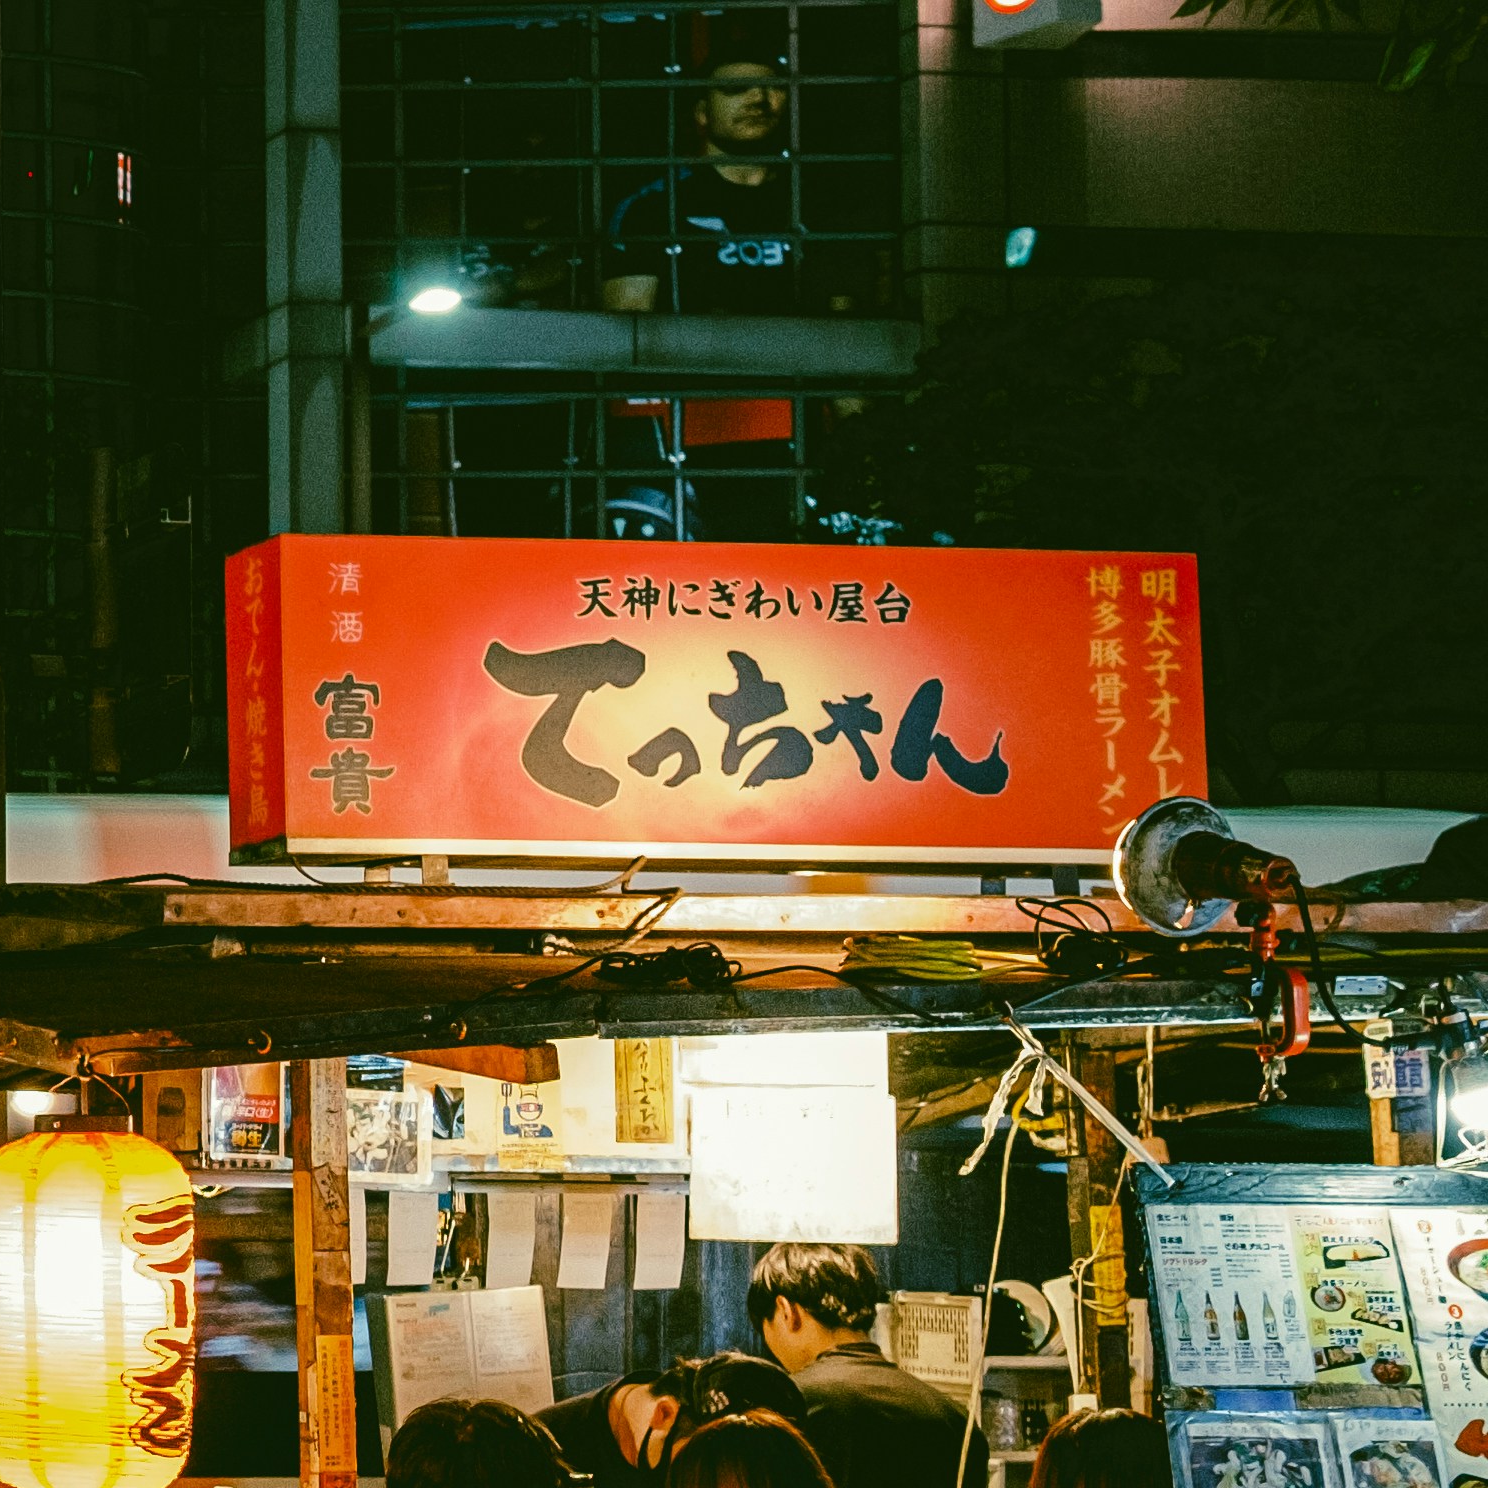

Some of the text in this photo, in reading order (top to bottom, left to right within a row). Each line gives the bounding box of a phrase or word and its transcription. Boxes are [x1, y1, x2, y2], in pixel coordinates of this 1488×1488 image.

[309, 562, 395, 815] 清酒 富貴
[575, 574, 914, 625] 天神にぎわい屋台
[1140, 568, 1184, 800] 明太子オムレ
[483, 637, 1010, 809] てっちゃん
